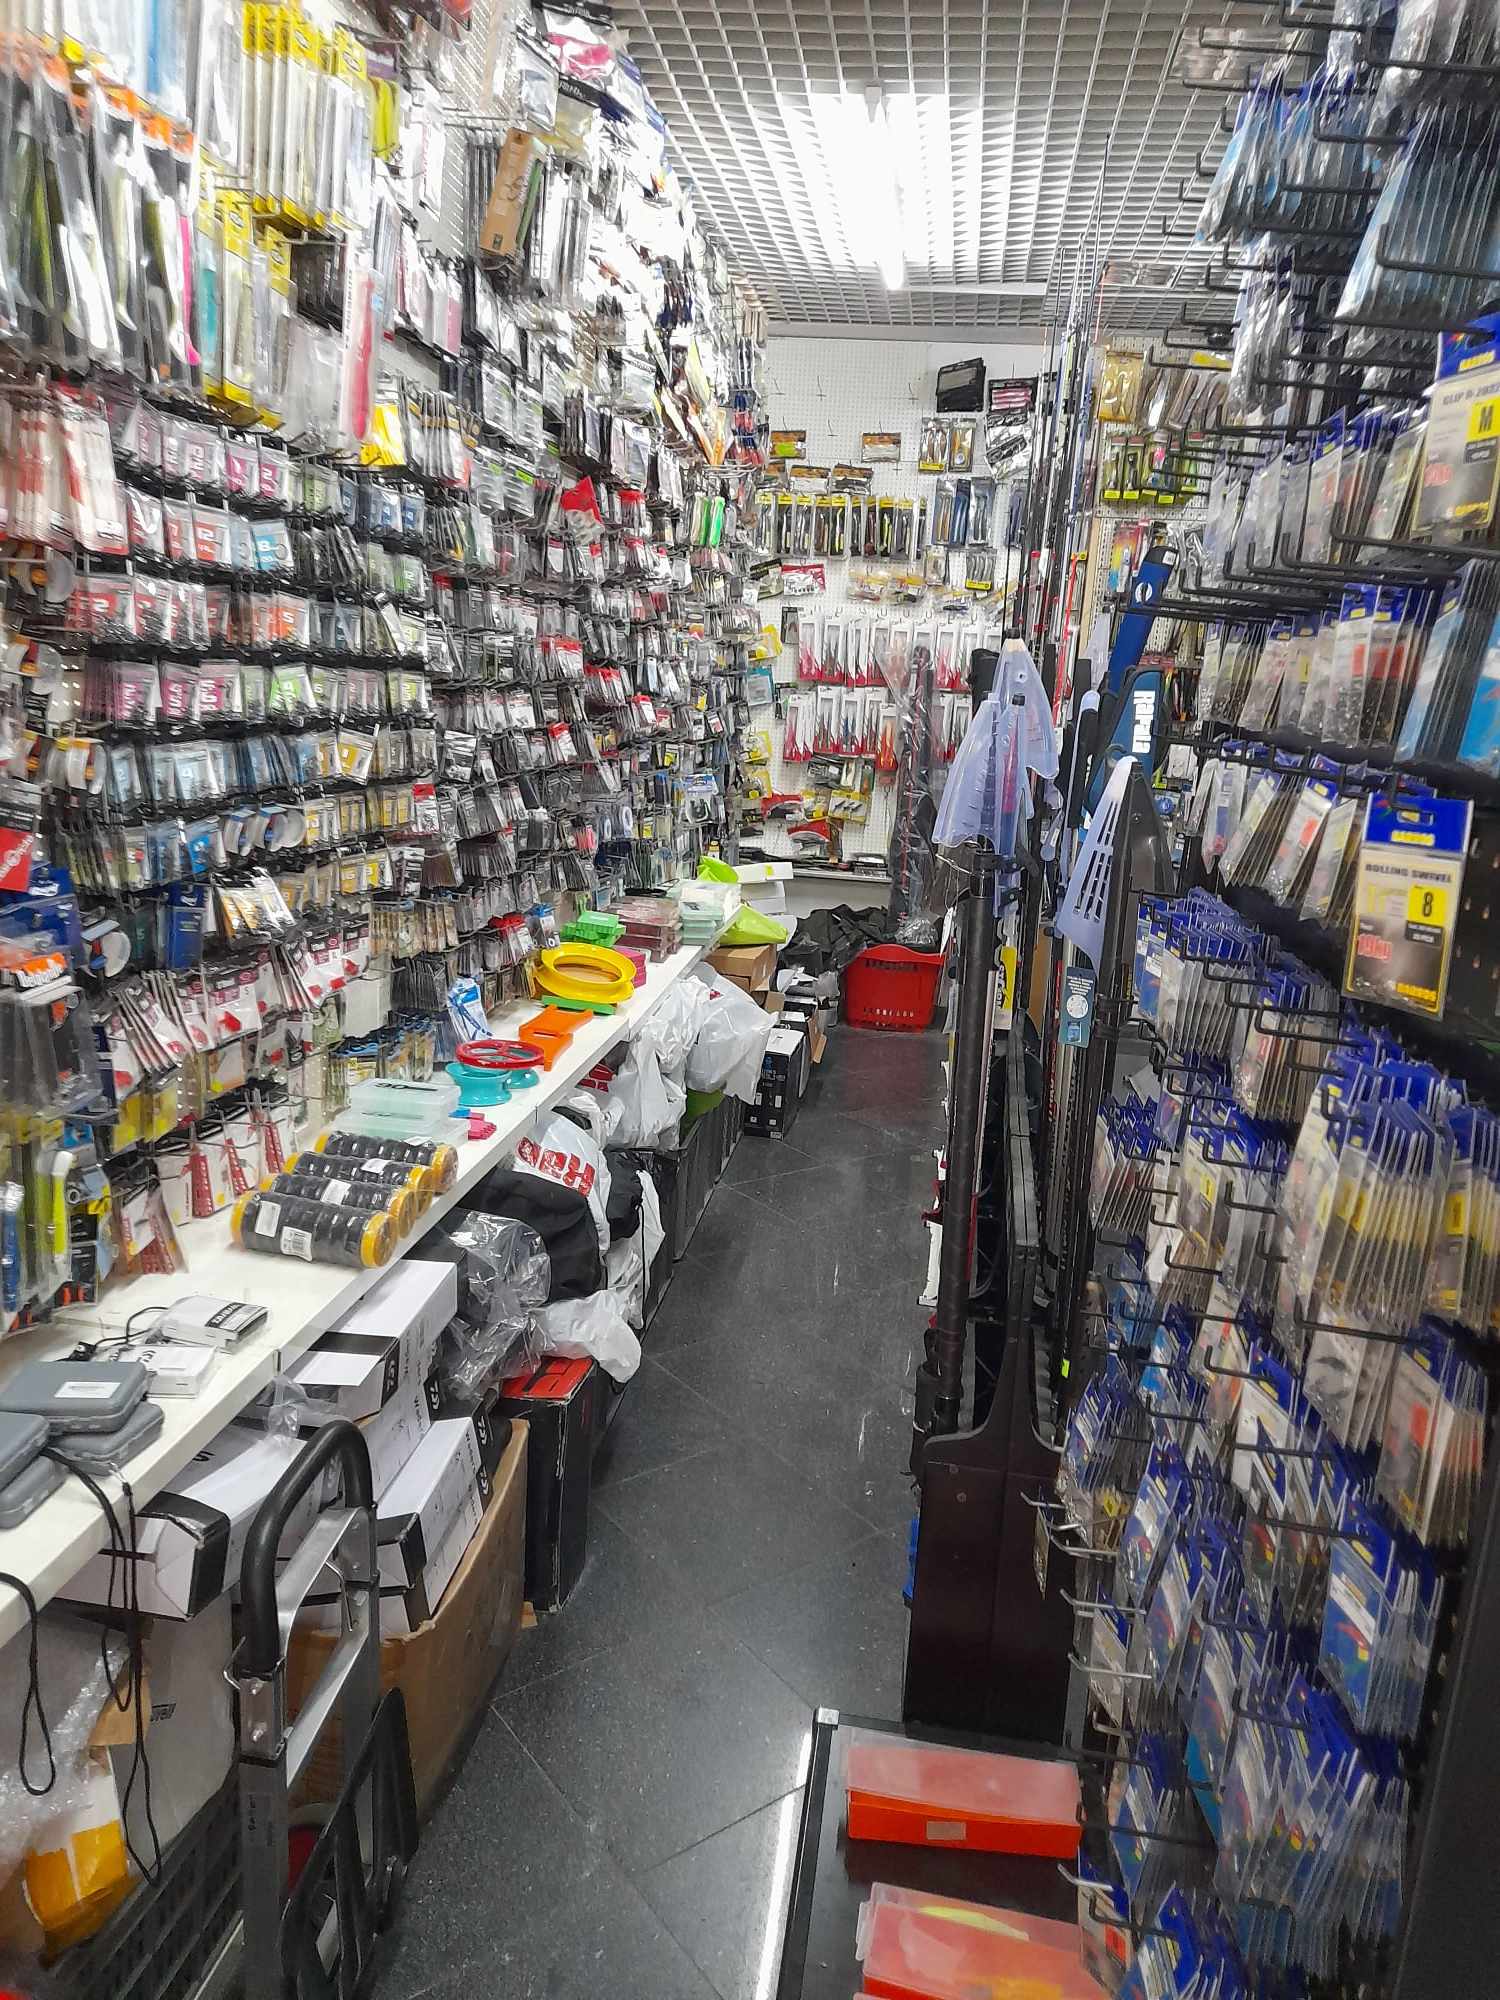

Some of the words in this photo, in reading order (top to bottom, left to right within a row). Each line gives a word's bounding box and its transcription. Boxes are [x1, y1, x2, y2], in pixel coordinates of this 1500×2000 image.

[1366, 863, 1408, 877] ROLLING
[1413, 870, 1452, 883] SWIVEL
[1422, 891, 1434, 918] 8
